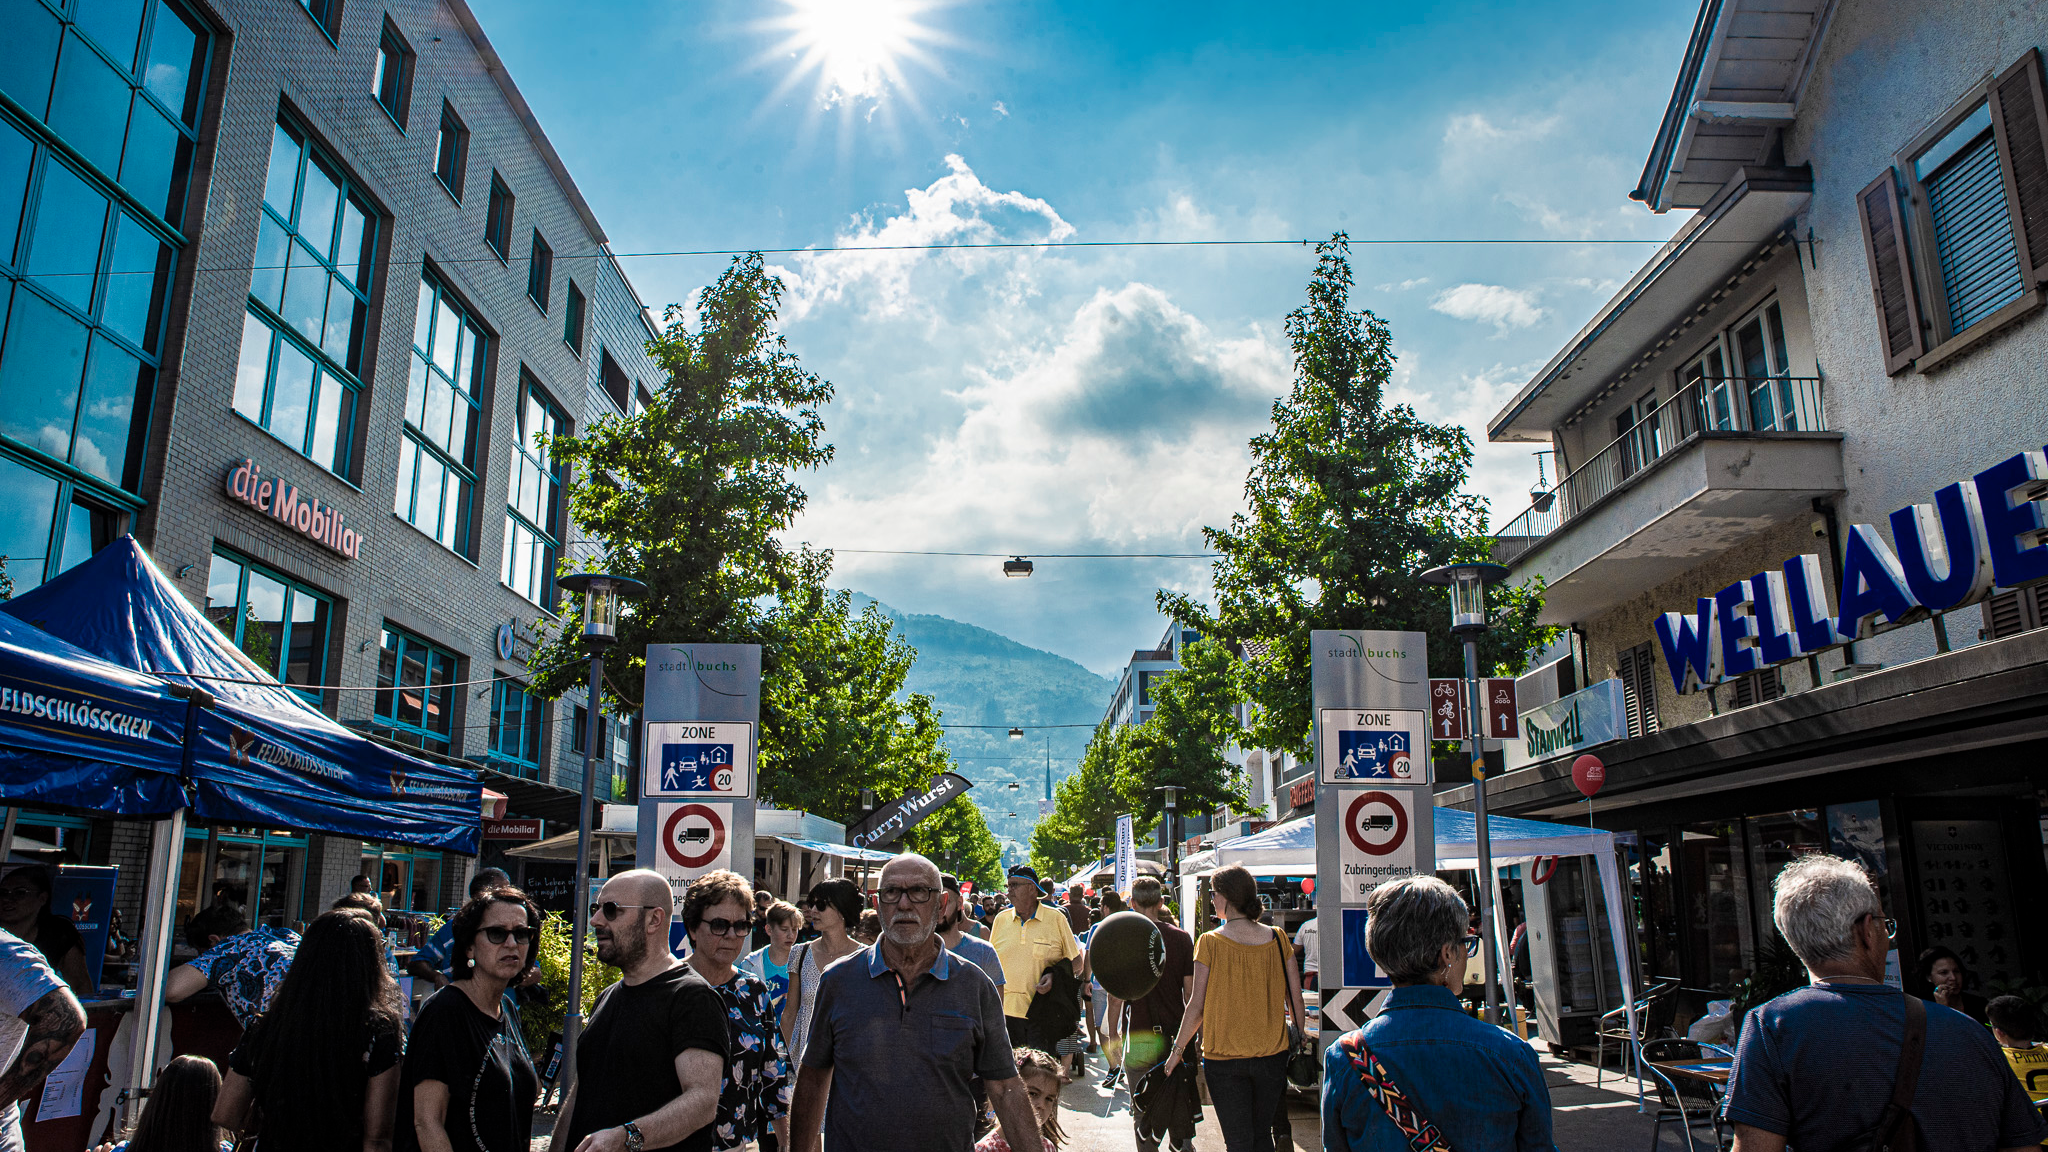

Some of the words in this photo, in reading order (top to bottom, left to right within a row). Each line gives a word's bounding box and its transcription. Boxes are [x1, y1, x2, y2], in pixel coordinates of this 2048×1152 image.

[1654, 445, 2048, 694] WELLAUE
[1328, 648, 1357, 658] stadt
[1368, 648, 1407, 659] buchs
[658, 661, 687, 671] stadt
[698, 661, 737, 671] buchs
[0, 687, 153, 740] ELDSCHLÖSSCHEN
[1357, 713, 1391, 726] ZONE
[681, 727, 716, 739] ZONE
[1526, 699, 1584, 758] STANWELL
[1397, 761, 1410, 773] 20
[718, 774, 732, 785] 20
[853, 778, 954, 849] CurryWurst
[1344, 864, 1412, 878] Zubringerdienst
[2013, 1051, 2048, 1063] Pirmi
